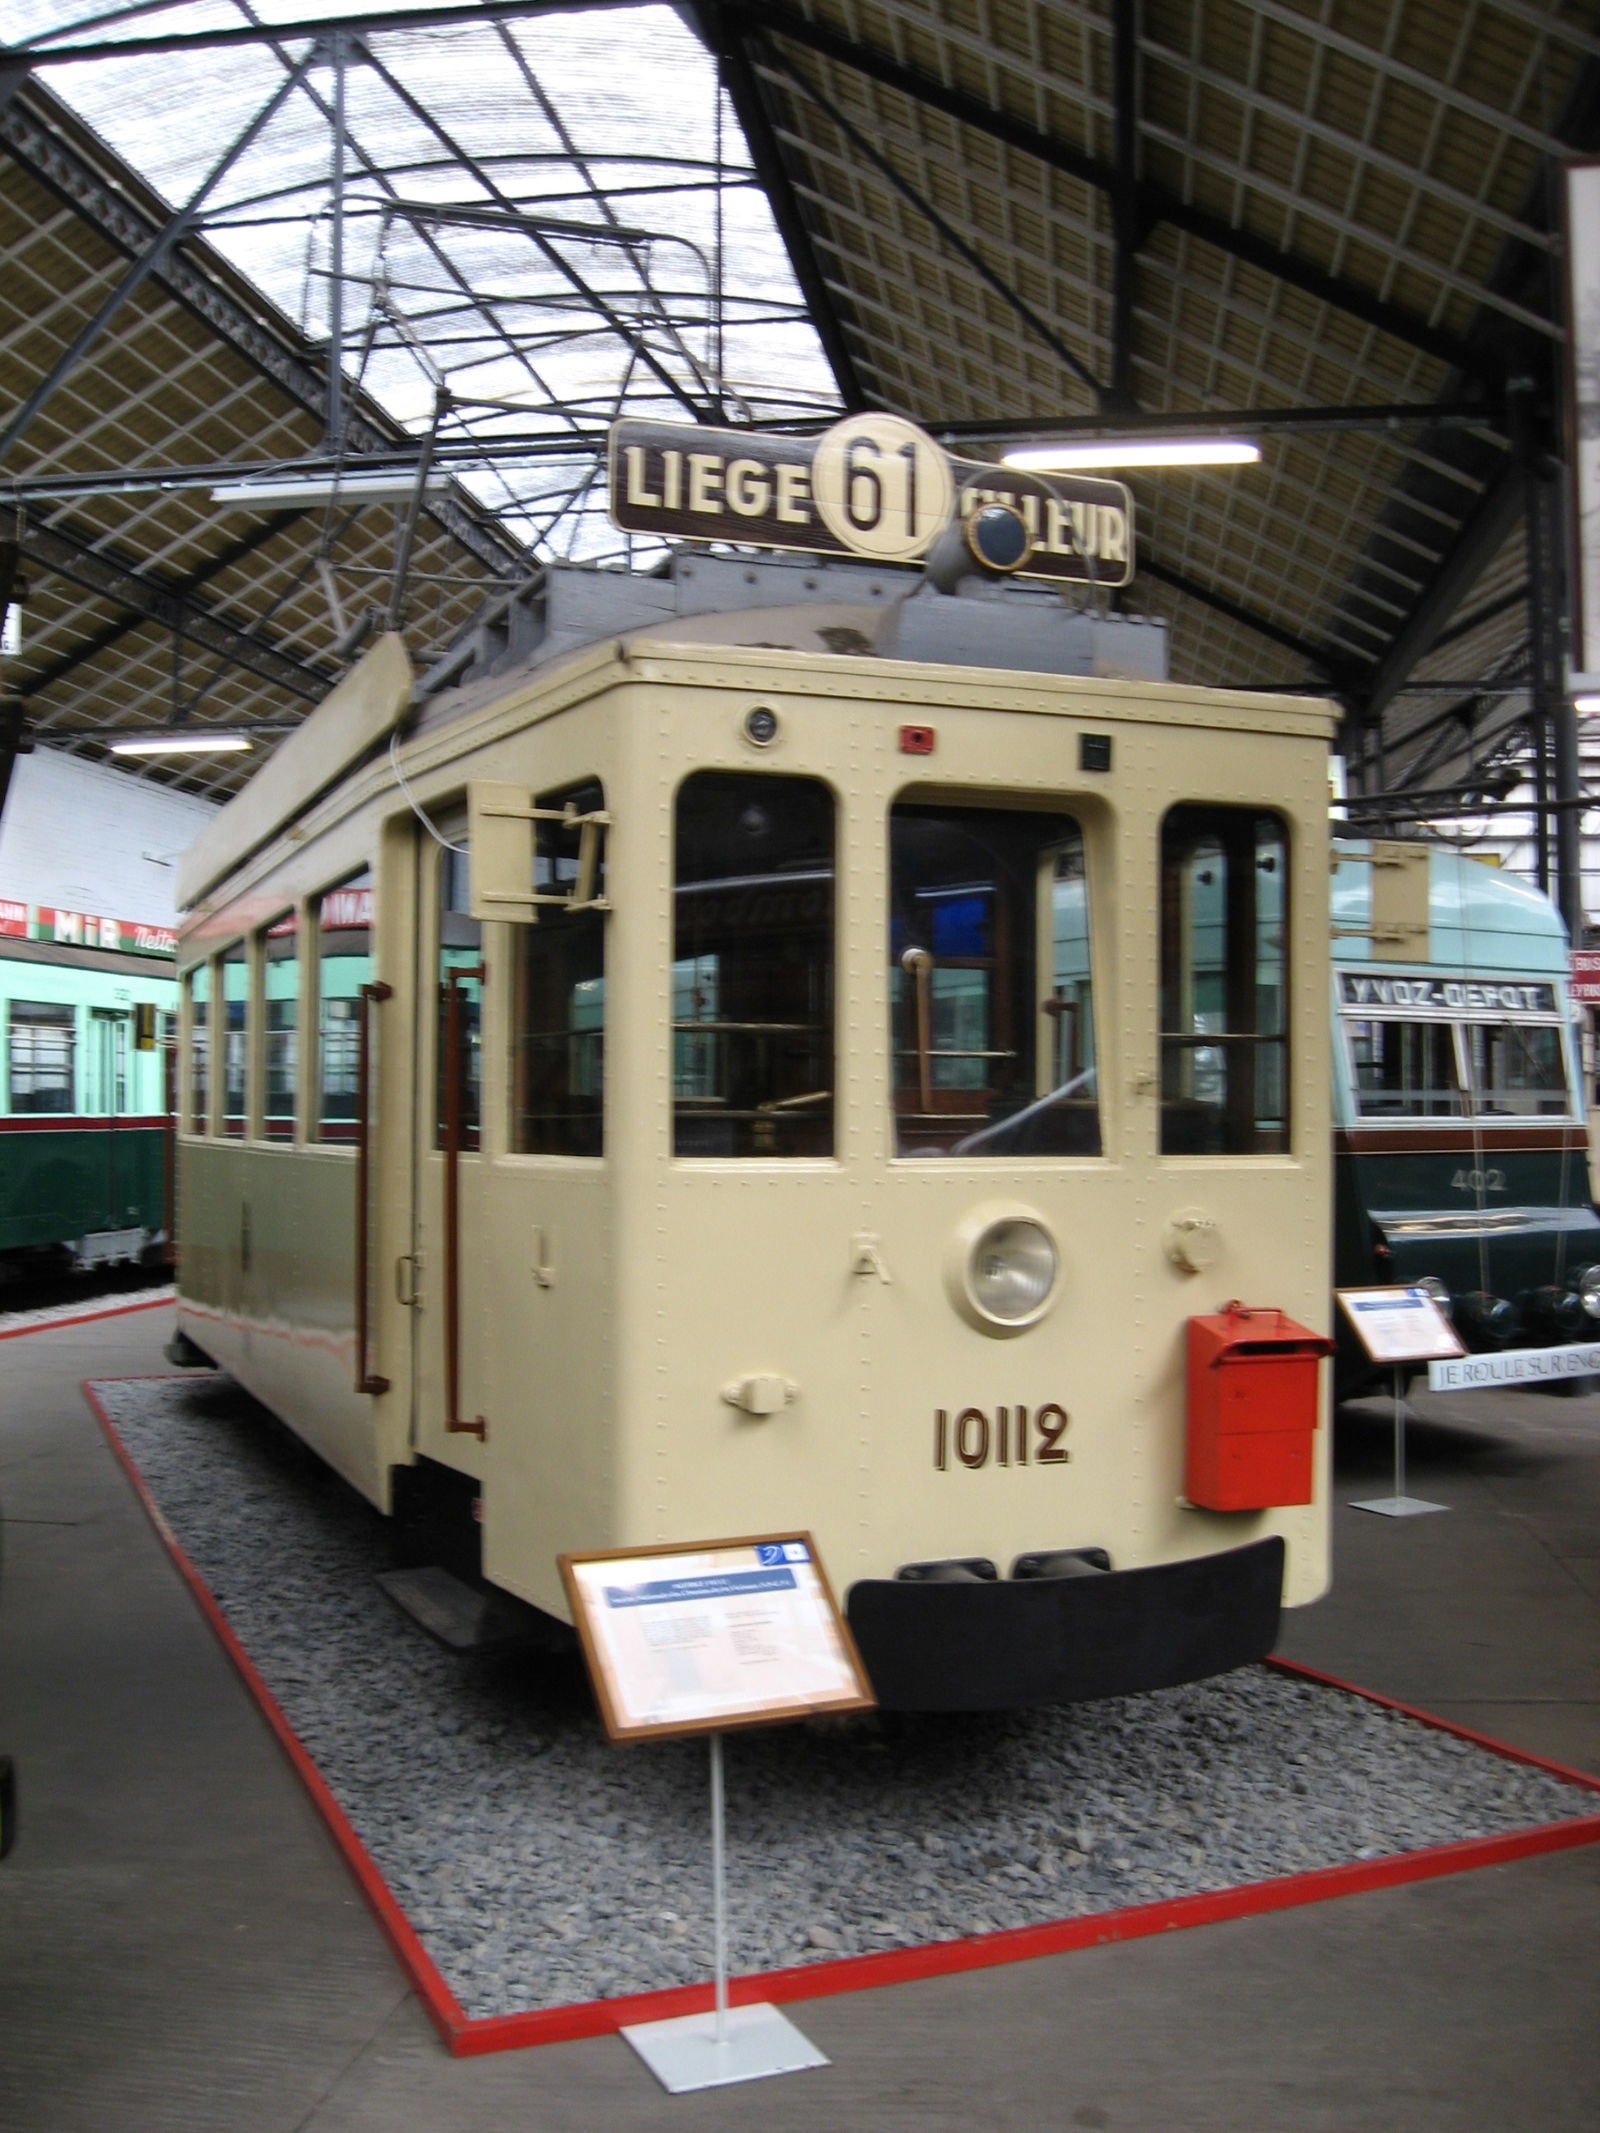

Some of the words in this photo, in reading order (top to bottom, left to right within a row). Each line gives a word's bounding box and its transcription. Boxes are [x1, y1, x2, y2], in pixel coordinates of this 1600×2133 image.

[623, 446, 811, 525] LIEGE
[842, 435, 918, 538] 61
[960, 486, 1128, 562] LEUR
[1352, 977, 1540, 1010] YVOZ-DEPOT
[1451, 1167, 1508, 1192] 402
[1463, 1359, 1525, 1382] ROULE
[933, 1402, 1069, 1471] 10112
